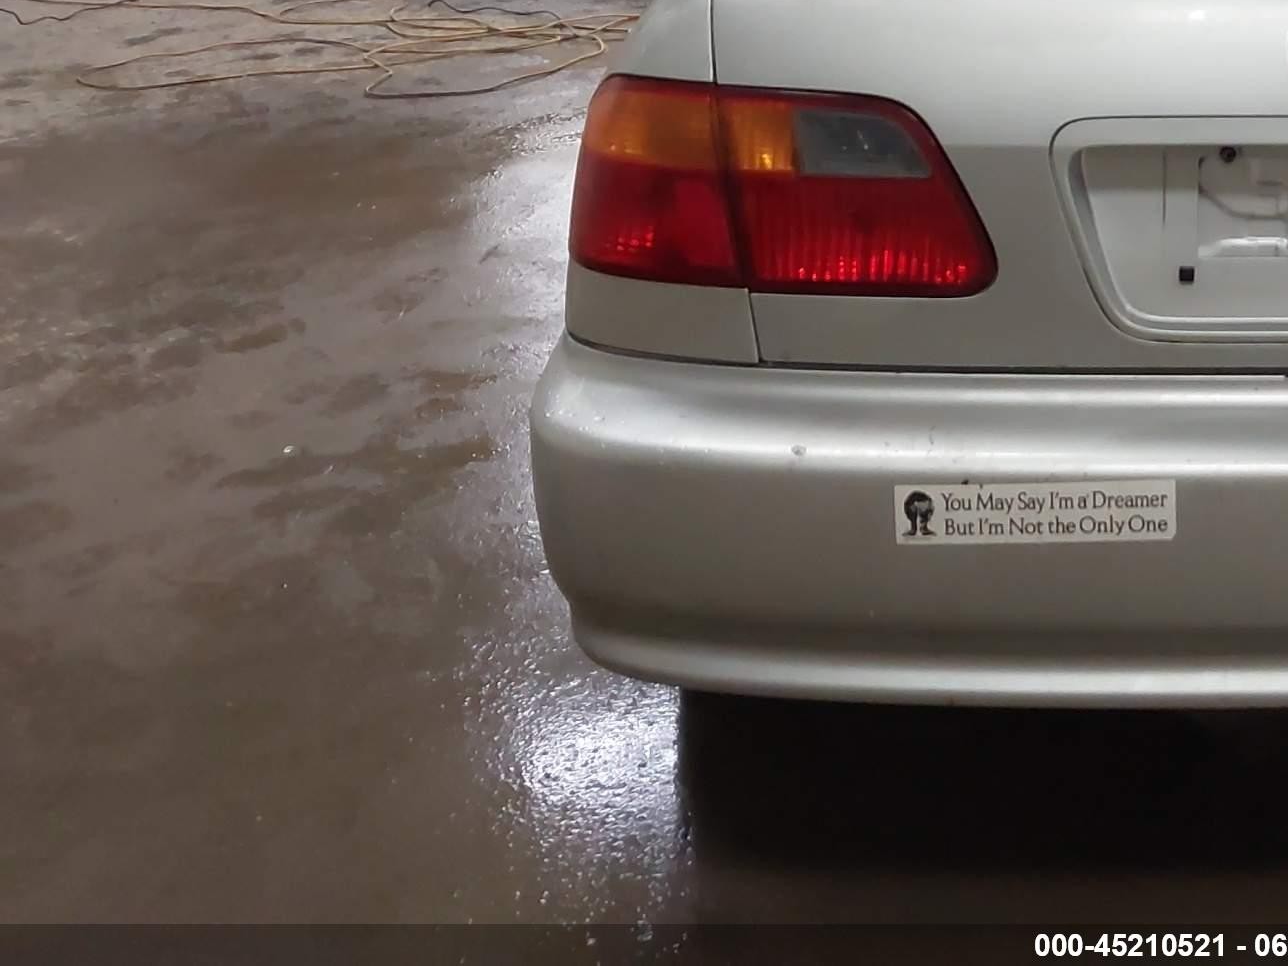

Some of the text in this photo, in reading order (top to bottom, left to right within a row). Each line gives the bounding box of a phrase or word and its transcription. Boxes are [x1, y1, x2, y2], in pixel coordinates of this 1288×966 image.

[941, 490, 1168, 515] You May Say I'm a Dreamer
[944, 514, 1168, 536] But I'm Not the Only One
